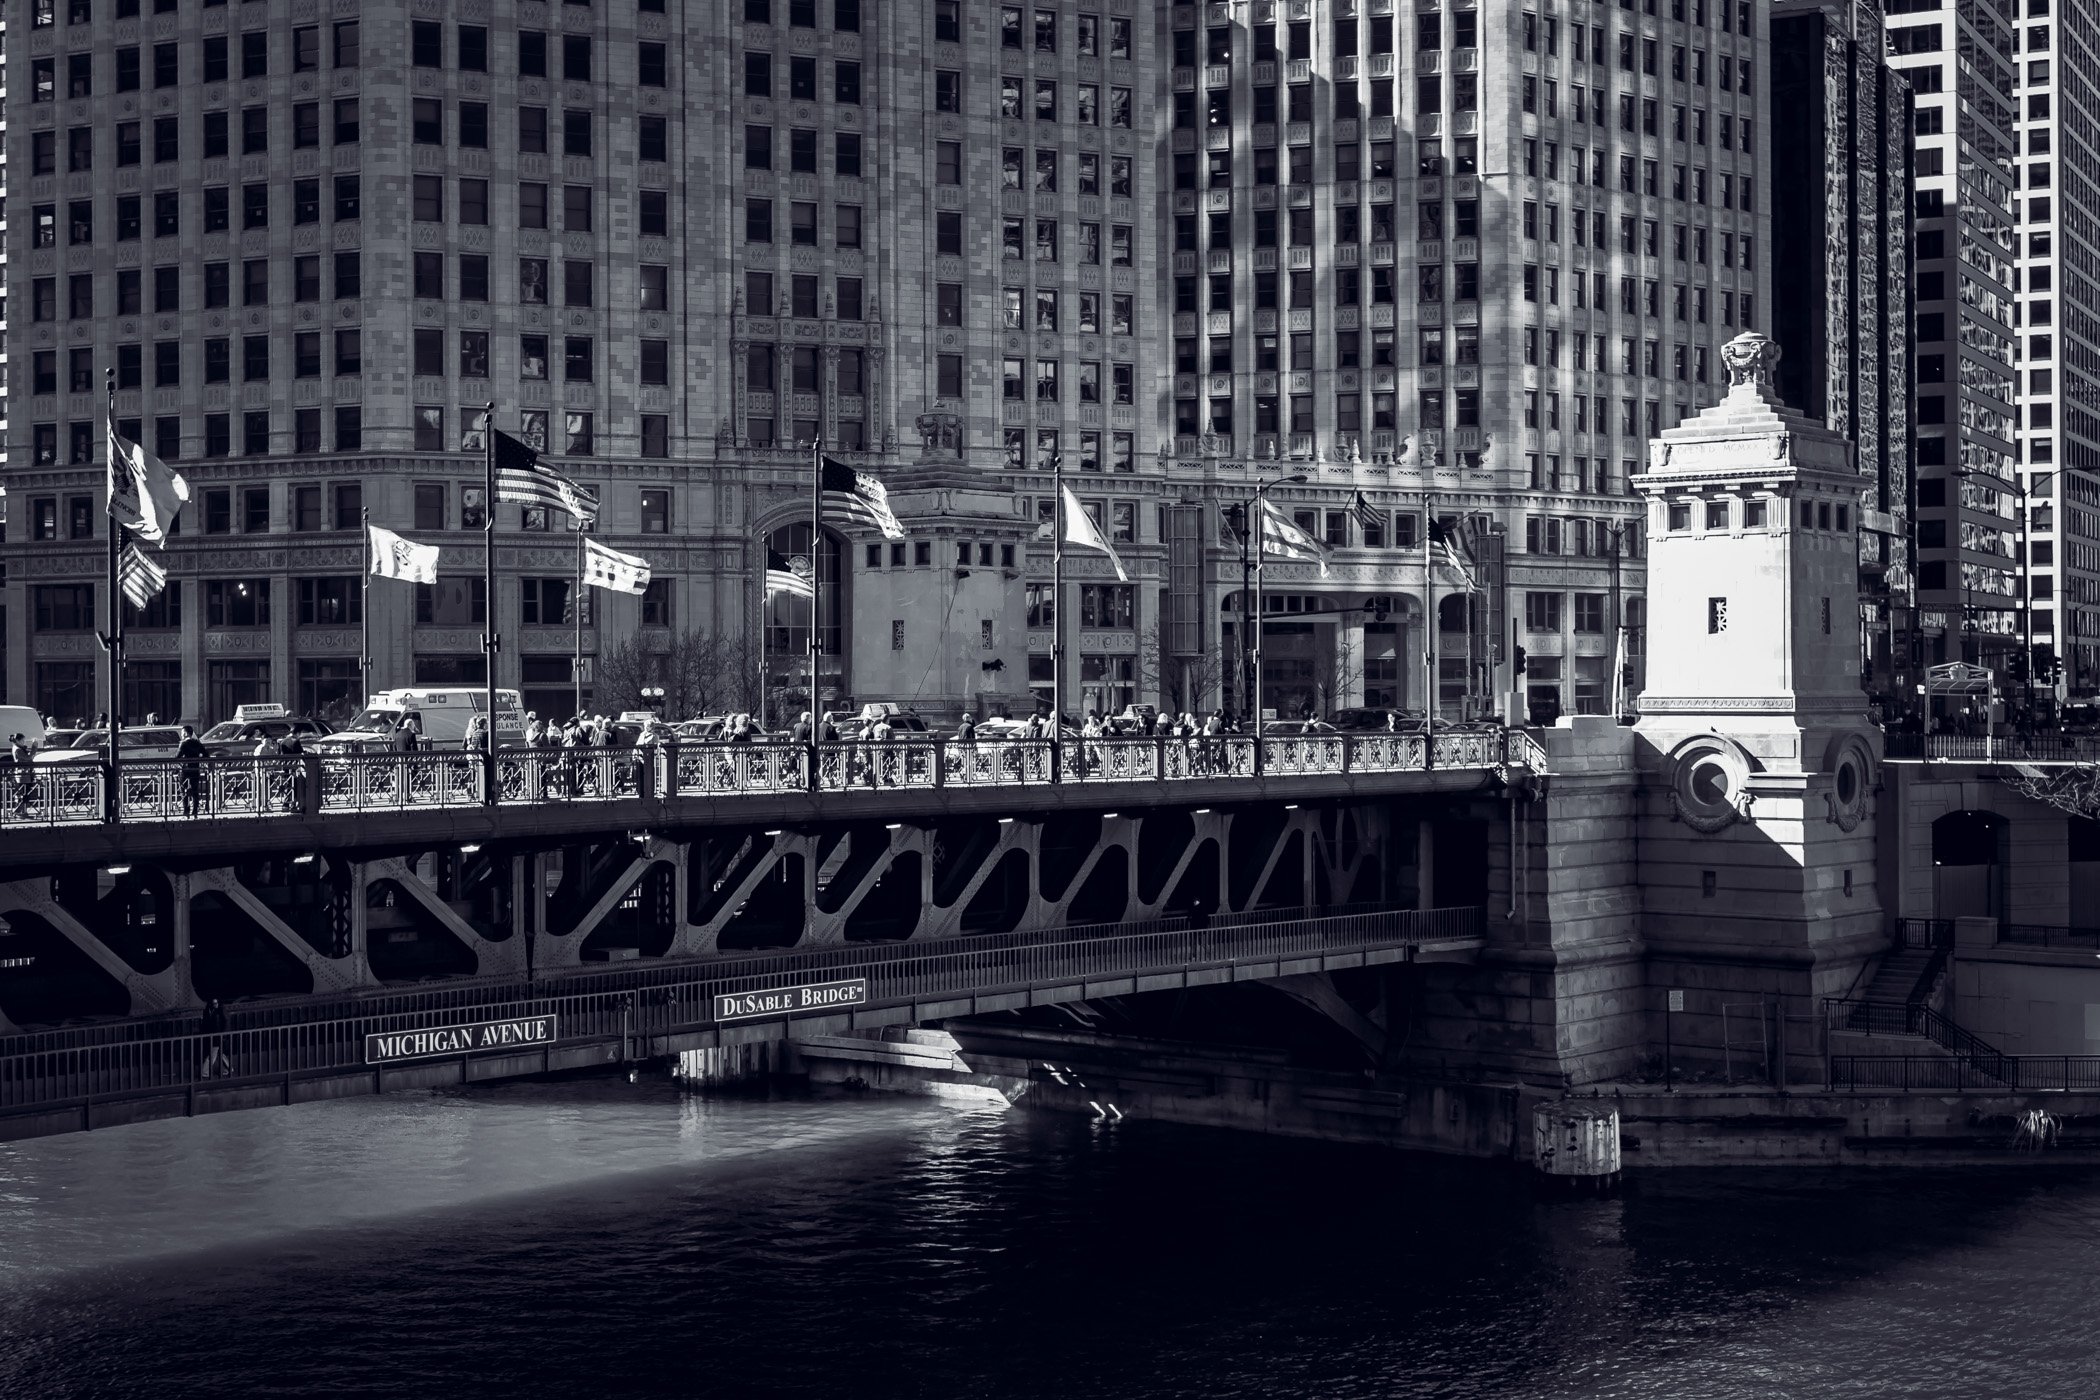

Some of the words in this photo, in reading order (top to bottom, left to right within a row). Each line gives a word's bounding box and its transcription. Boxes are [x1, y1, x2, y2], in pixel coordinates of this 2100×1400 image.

[801, 986, 857, 1006] BRIDGE
[377, 1028, 472, 1058] MICHIGAN
[480, 1020, 547, 1046] AVENUE
